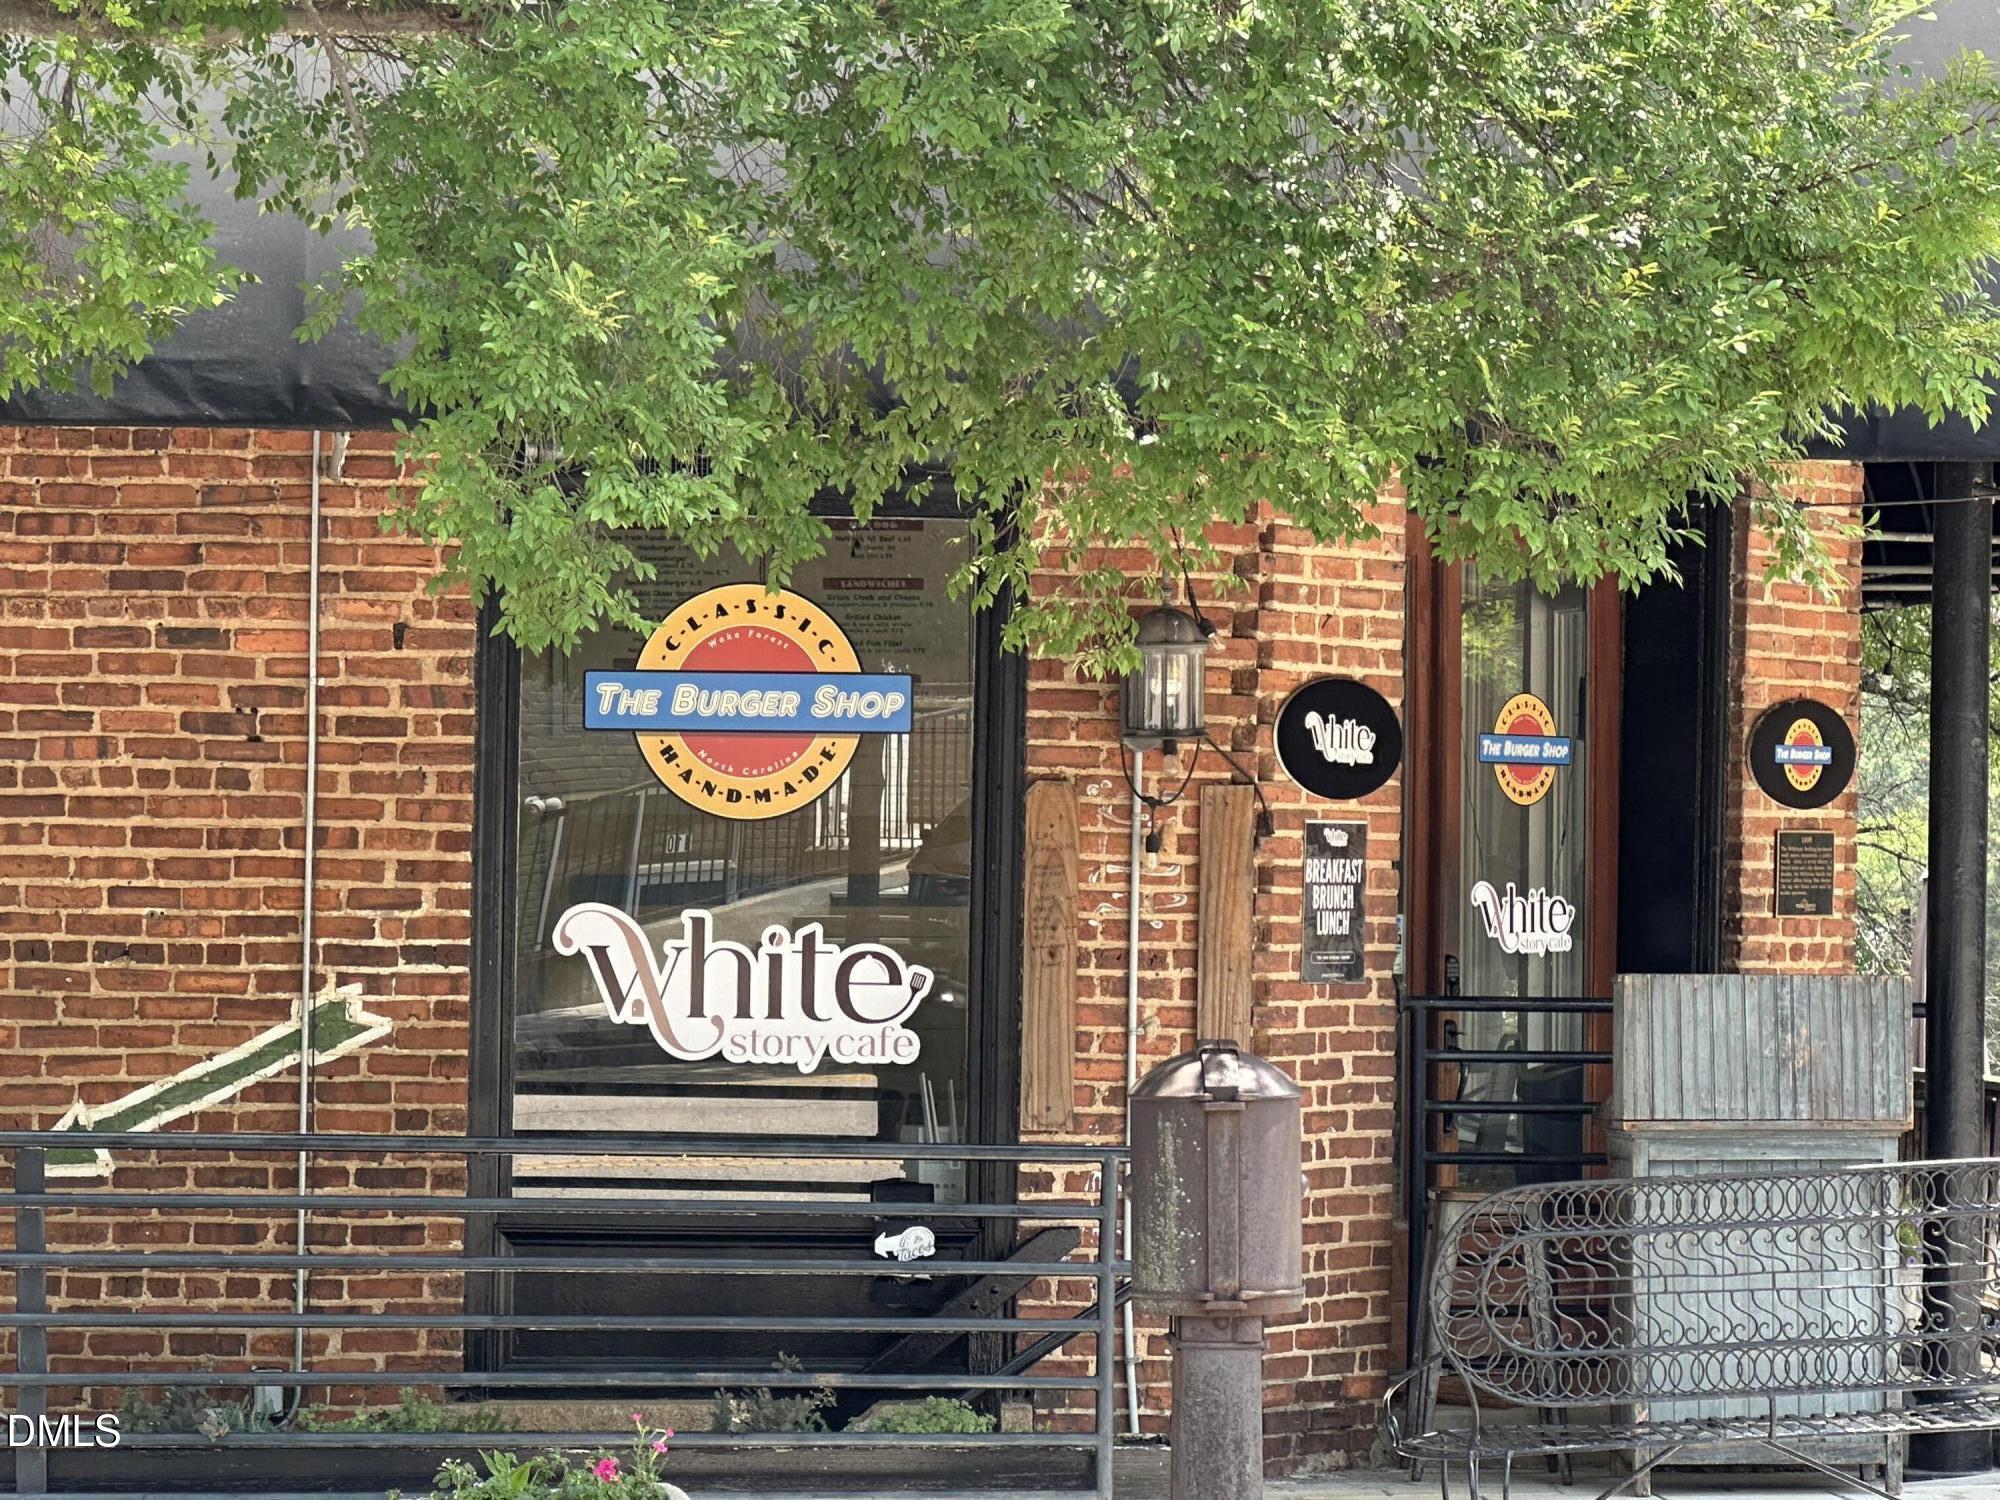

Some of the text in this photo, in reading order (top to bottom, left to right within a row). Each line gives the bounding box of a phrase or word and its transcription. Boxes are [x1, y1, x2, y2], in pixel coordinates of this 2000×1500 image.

[748, 629, 790, 650] Forest
[596, 682, 905, 719] THE BURGER SHOP
[1306, 712, 1376, 761] White
[1482, 739, 1569, 759] THE BURGER SHOP
[697, 749, 799, 776] North Carolina
[1305, 858, 1363, 884] BREAKFAST
[1312, 885, 1354, 910] BRUNCH
[1316, 911, 1350, 936] LUNCH
[1472, 883, 1574, 951] White
[1519, 938, 1547, 956] story
[558, 908, 928, 1055] White
[729, 1026, 914, 1065] story cafe
